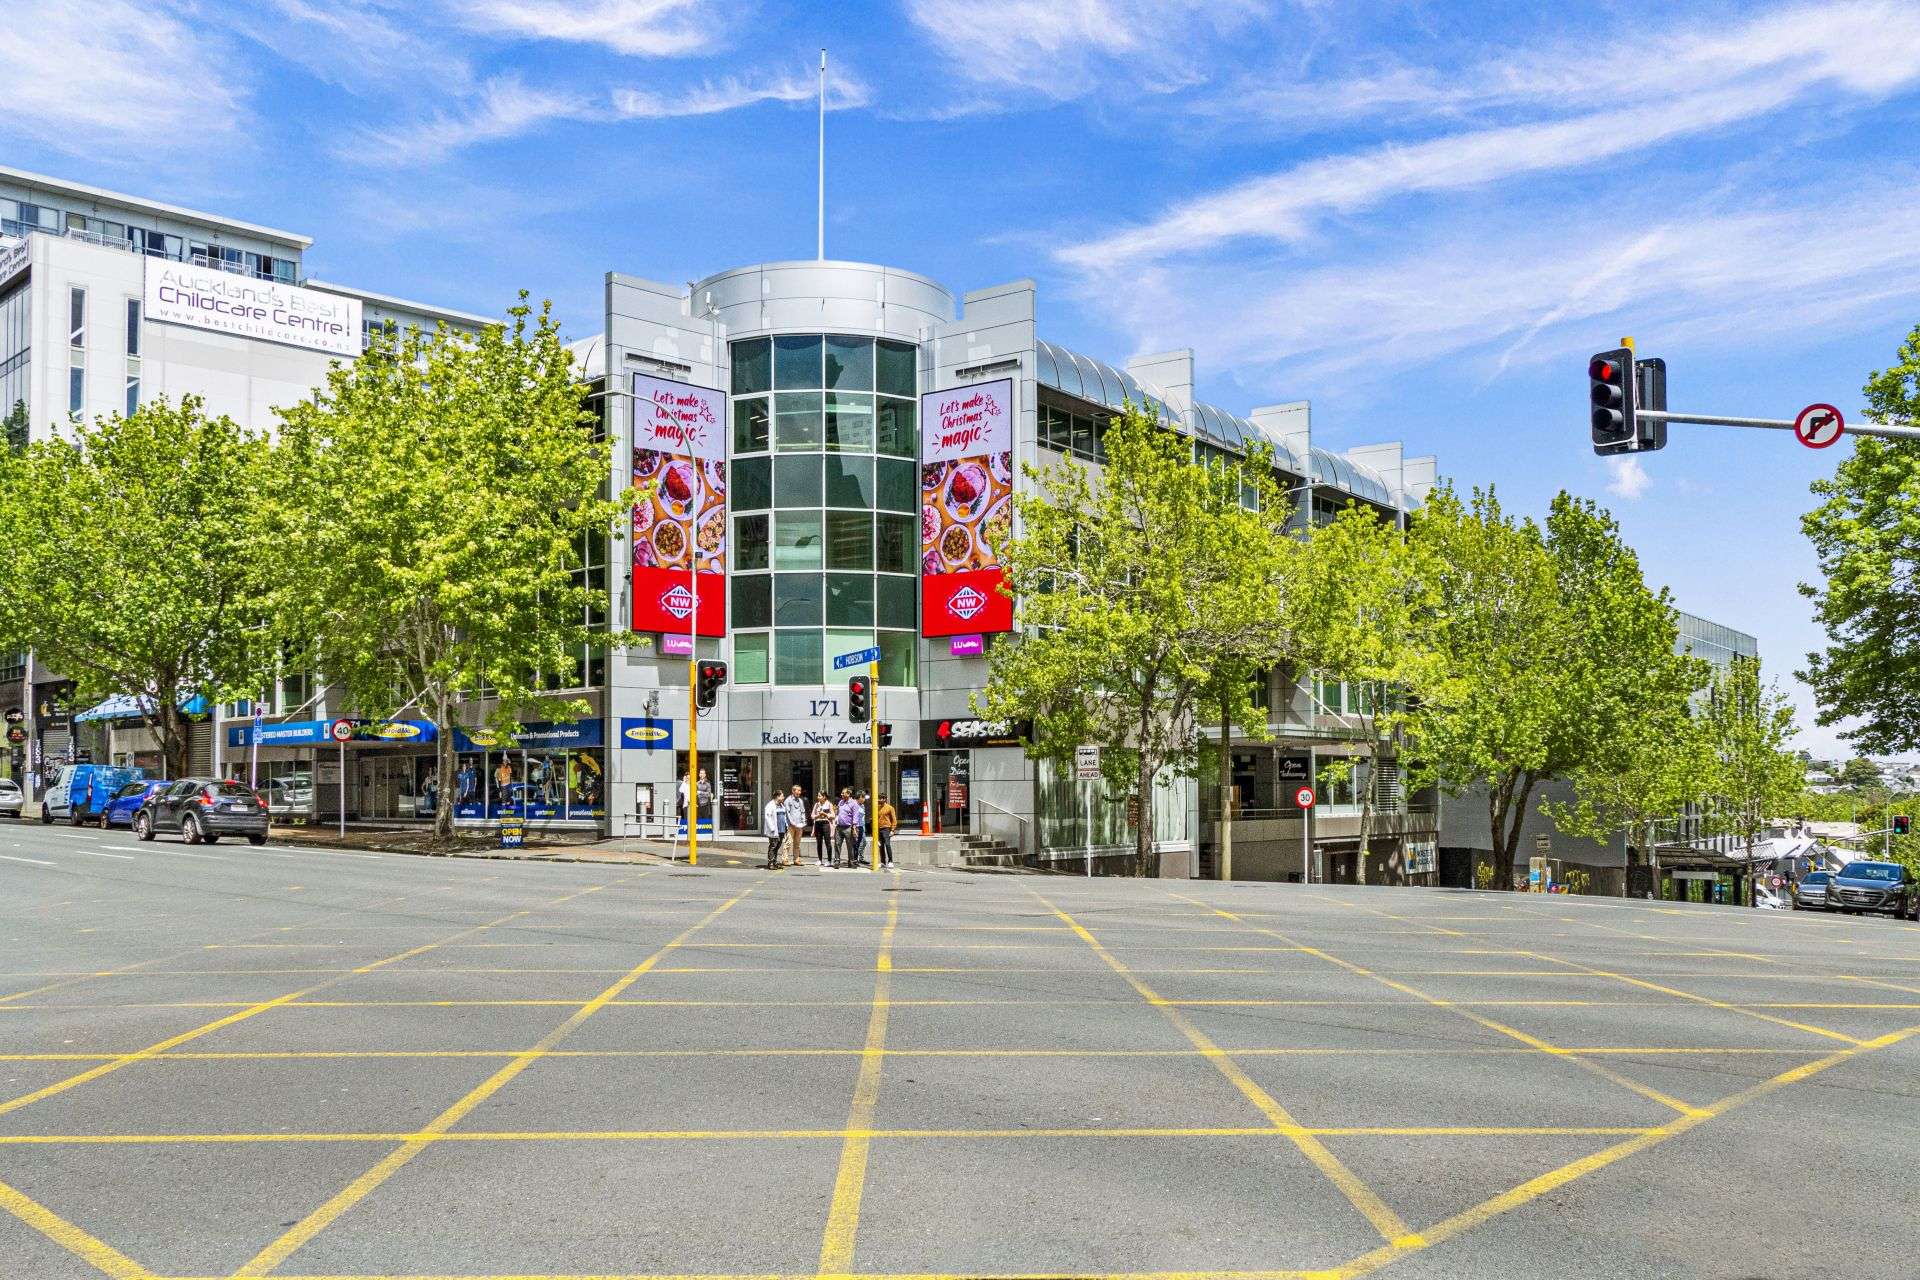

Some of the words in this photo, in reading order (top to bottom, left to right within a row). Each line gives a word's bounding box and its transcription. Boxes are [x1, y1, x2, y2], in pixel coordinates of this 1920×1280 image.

[160, 270, 284, 307] Auckland's
[290, 295, 340, 318] Best
[160, 287, 266, 320] Childcare
[653, 389, 674, 405] Let's
[676, 393, 699, 408] make
[939, 400, 960, 417] Let's
[961, 392, 984, 411] make
[942, 411, 983, 430] Christmas
[655, 423, 697, 447] magic
[941, 424, 982, 452] magic
[670, 596, 691, 607] NW
[956, 598, 976, 608] NW
[809, 700, 841, 717] 171
[337, 726, 349, 735] 40
[534, 731, 559, 739] Promotional
[560, 730, 579, 738] Products
[761, 731, 799, 745] Radio
[803, 731, 833, 744] New
[837, 731, 872, 744] Zeala
[1300, 793, 1311, 802] 30
[501, 828, 523, 836] OPEN
